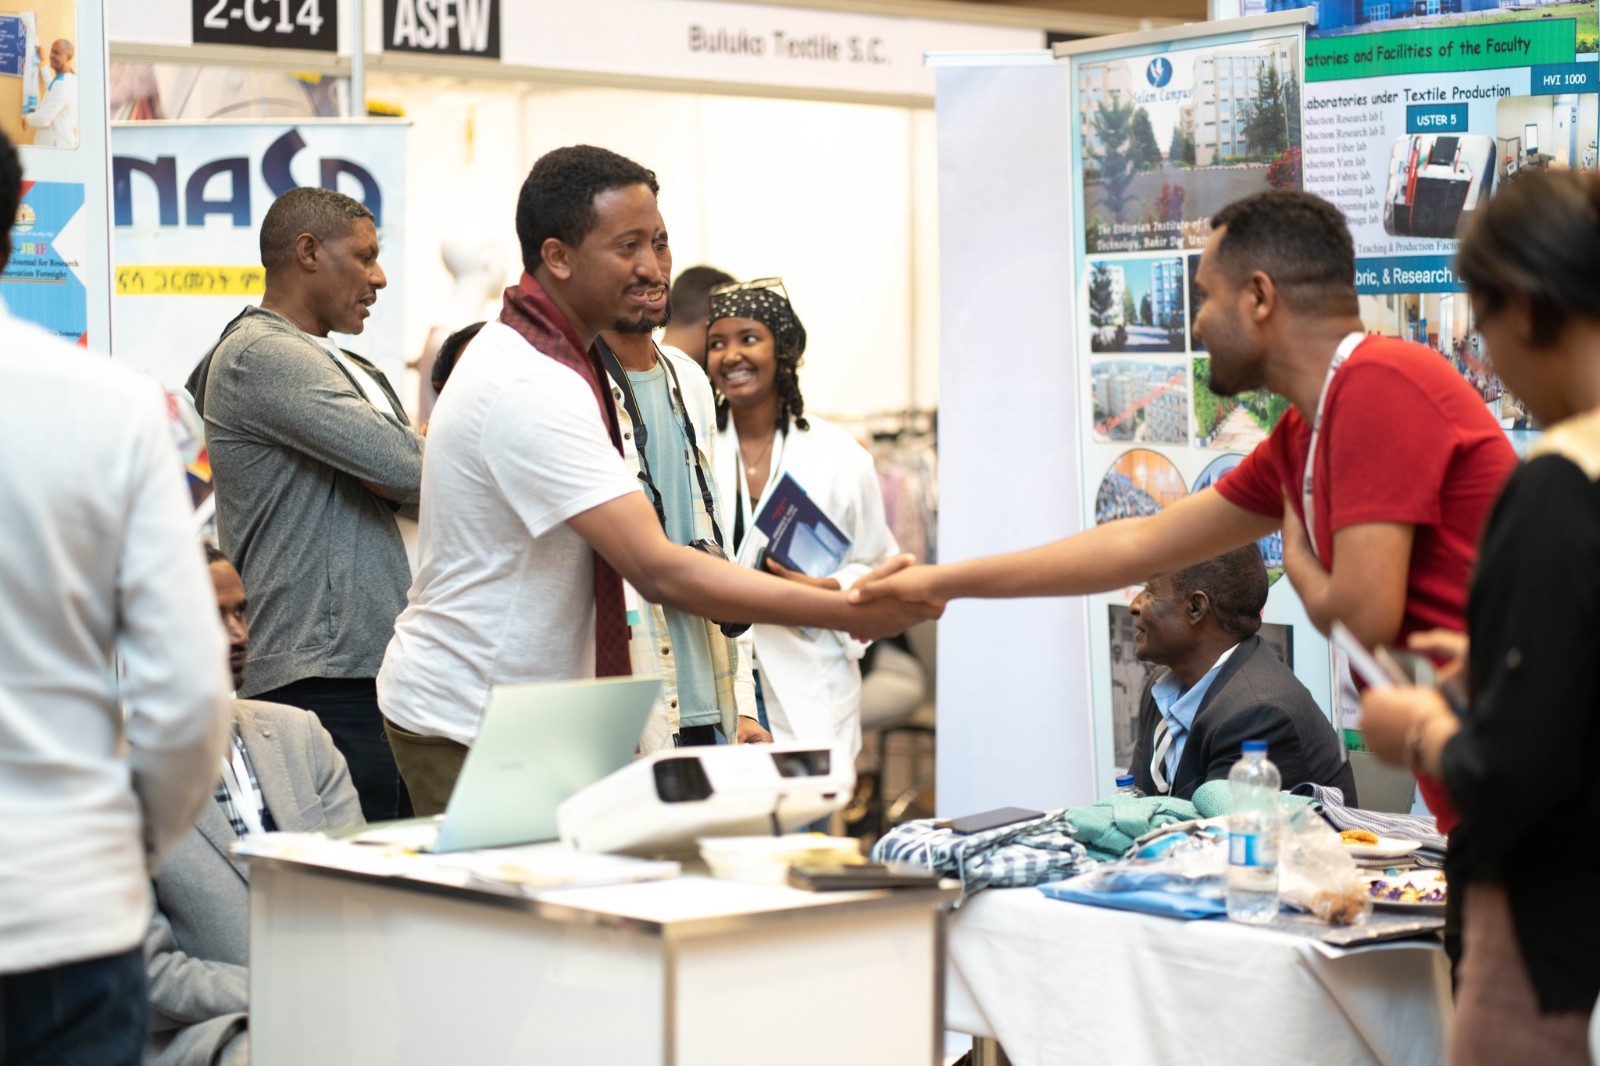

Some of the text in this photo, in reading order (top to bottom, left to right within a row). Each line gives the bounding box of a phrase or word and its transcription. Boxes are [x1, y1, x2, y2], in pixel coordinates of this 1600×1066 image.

[203, 0, 324, 36] 2-C14
[393, 0, 492, 51] ASFW
[772, 29, 842, 62] Textile
[1354, 46, 1373, 64] and
[1376, 43, 1433, 62] Facilities
[1439, 41, 1454, 57] of
[1460, 40, 1481, 55] the
[1486, 36, 1531, 56] Faculty
[1543, 74, 1587, 86] HVI 1000
[1304, 84, 1511, 110] aboratories under Textile Production
[1336, 112, 1368, 124] Research
[1369, 110, 1379, 122] lab
[1416, 114, 1457, 126] USTER 5
[1336, 127, 1368, 138] Research
[1369, 126, 1379, 136] lab
[1356, 141, 1368, 152] lab
[1356, 156, 1366, 166] lab
[1360, 170, 1371, 180] lab
[1365, 185, 1376, 195] lab
[1369, 200, 1380, 210] lab
[1369, 214, 1379, 224] lab
[1395, 241, 1434, 252] Production
[1436, 241, 1462, 250] Facto
[6, 258, 79, 268] -Journal for Research
[0, 269, 66, 280] nnovation Foresight
[1354, 268, 1380, 287] bric,
[1382, 268, 1390, 285] &
[1393, 266, 1452, 285] Research
